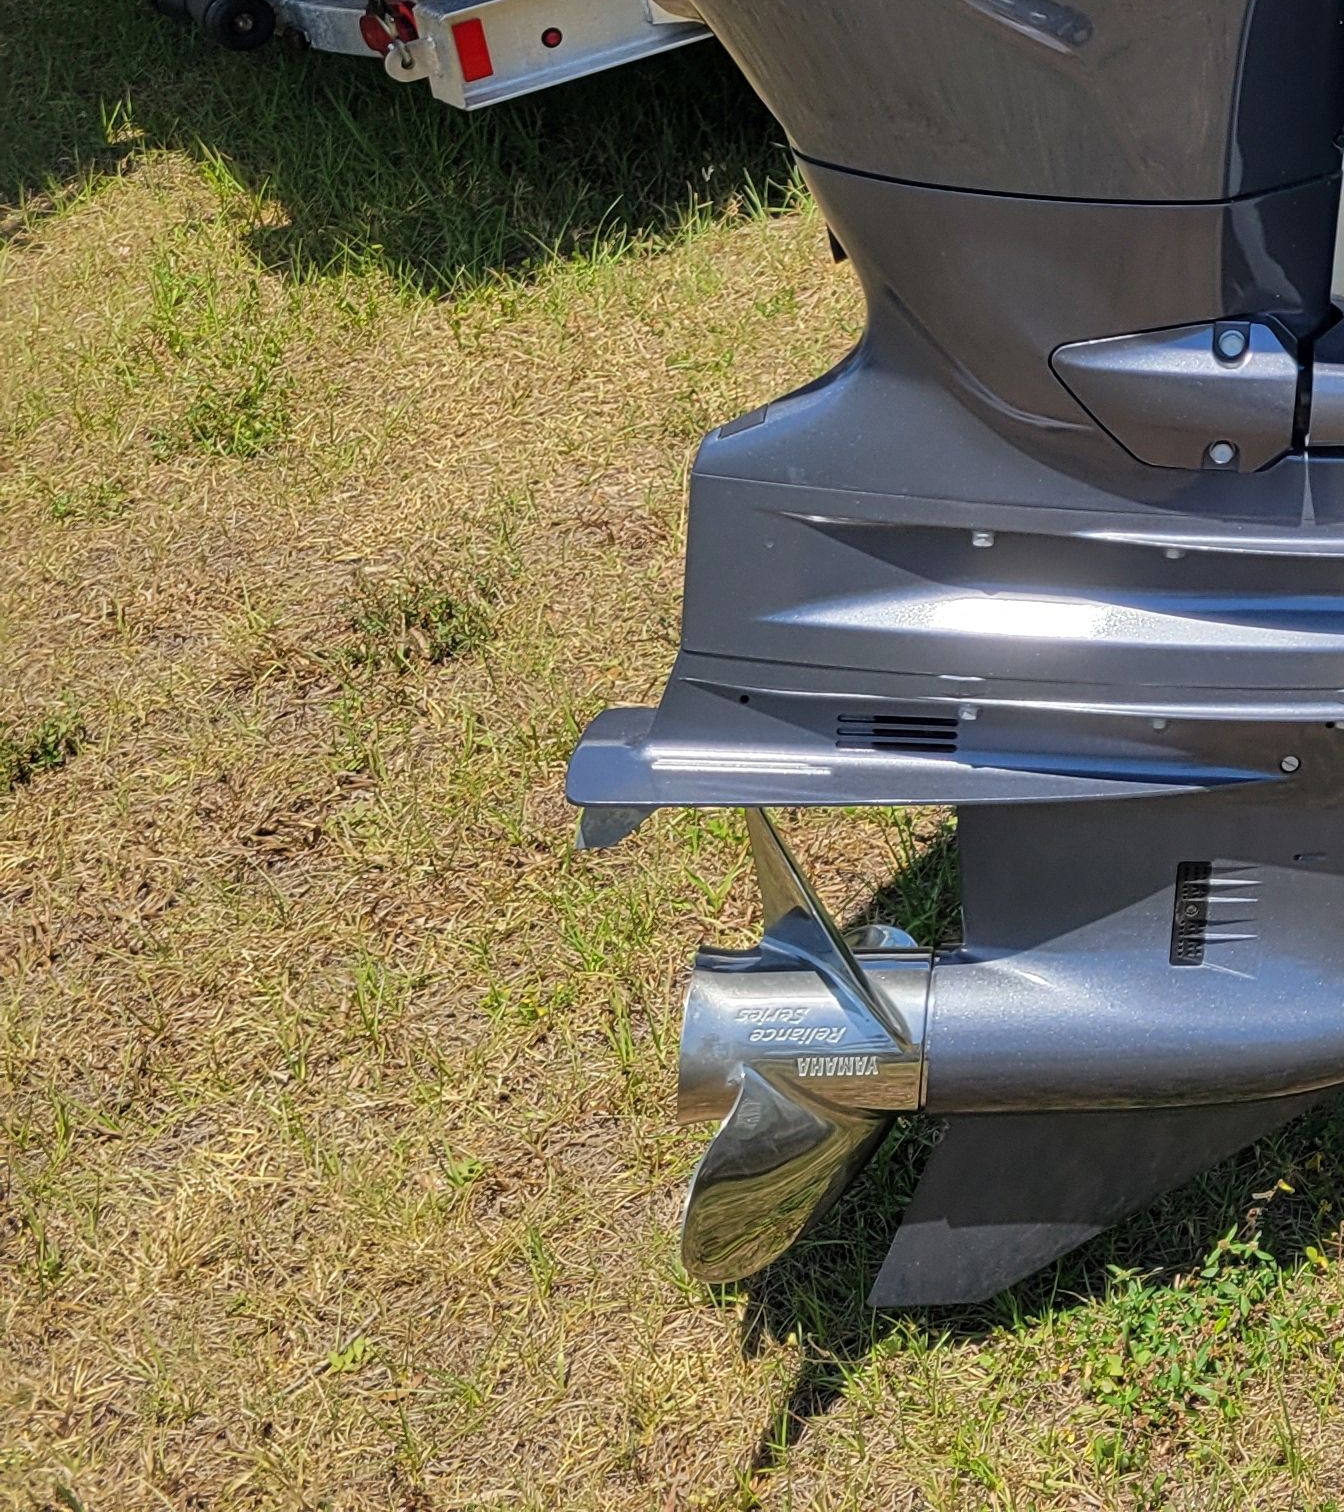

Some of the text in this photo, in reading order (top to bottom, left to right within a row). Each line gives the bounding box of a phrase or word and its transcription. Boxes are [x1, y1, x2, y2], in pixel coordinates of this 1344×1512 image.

[735, 1008, 810, 1027] Series
[750, 1026, 847, 1046] Reliance
[796, 1055, 880, 1078] YAMAHA
